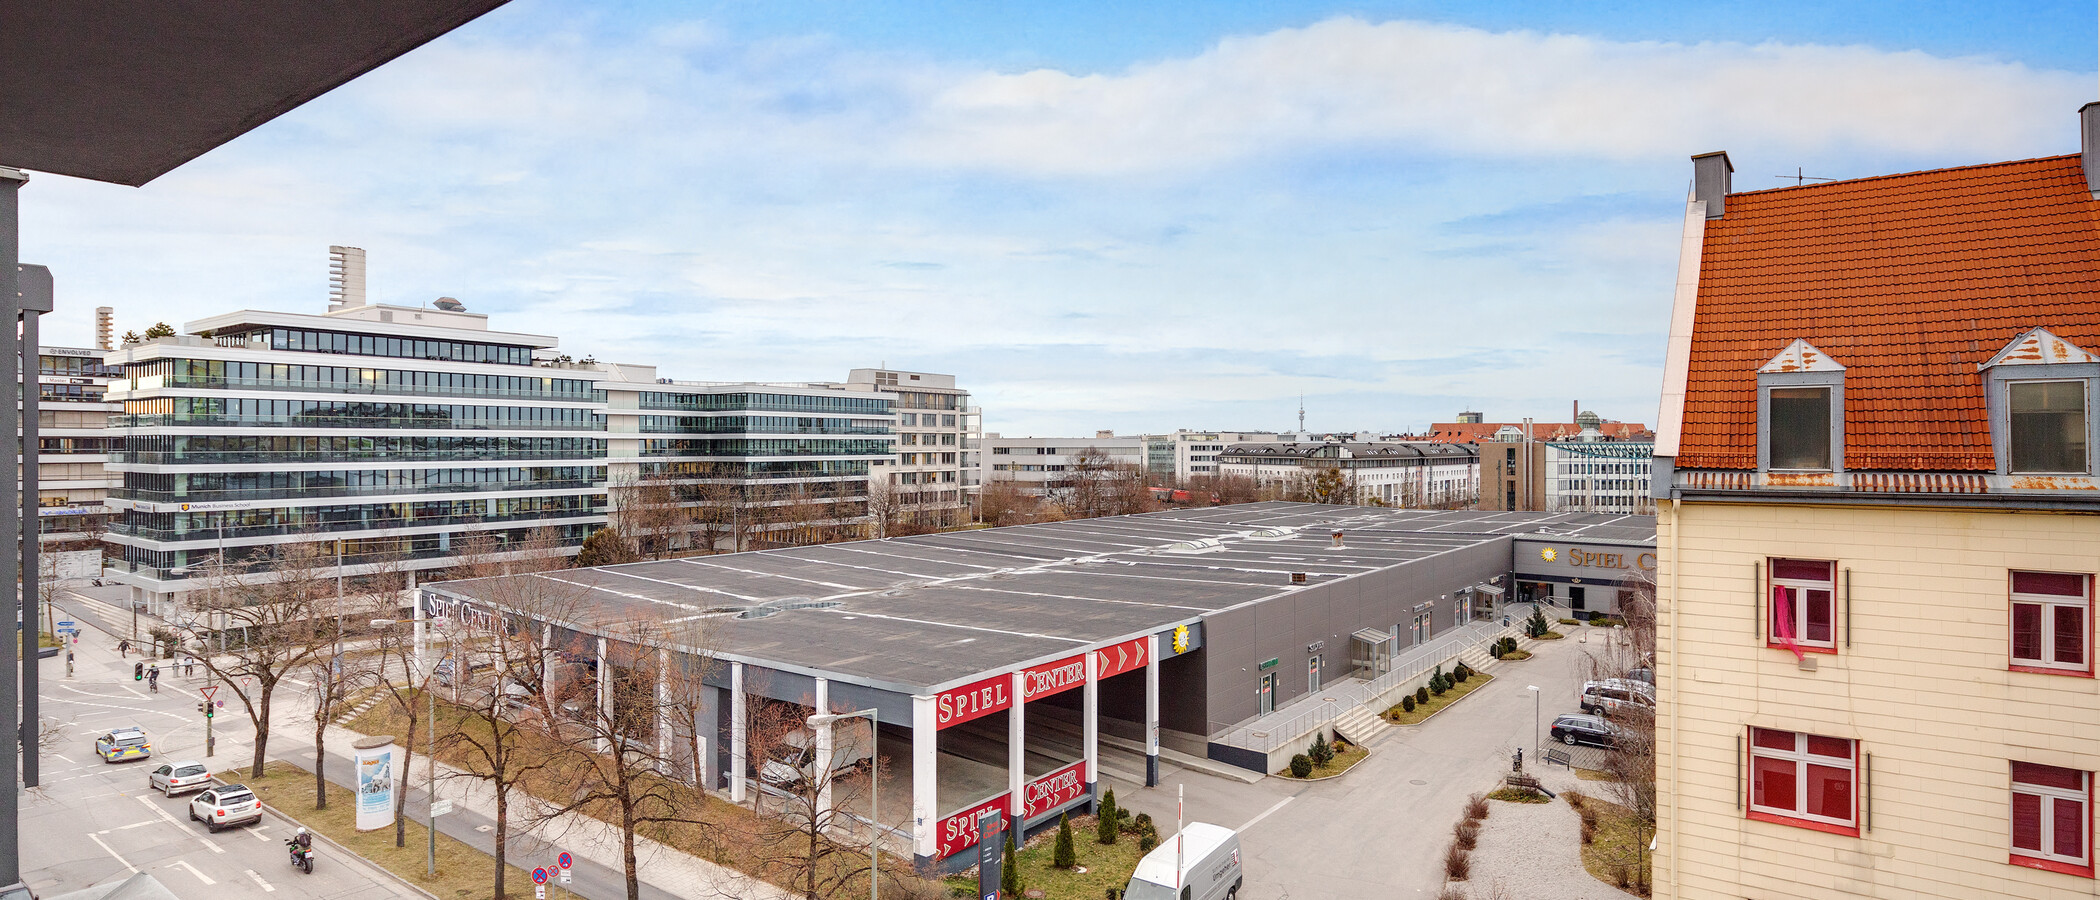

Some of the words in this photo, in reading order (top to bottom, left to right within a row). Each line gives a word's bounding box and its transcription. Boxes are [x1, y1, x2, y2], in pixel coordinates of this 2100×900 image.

[1569, 547, 1630, 570] SPIEL
[938, 683, 1008, 724] SPIEL
[1023, 661, 1085, 698] CENTER
[1025, 769, 1078, 805] CENTER
